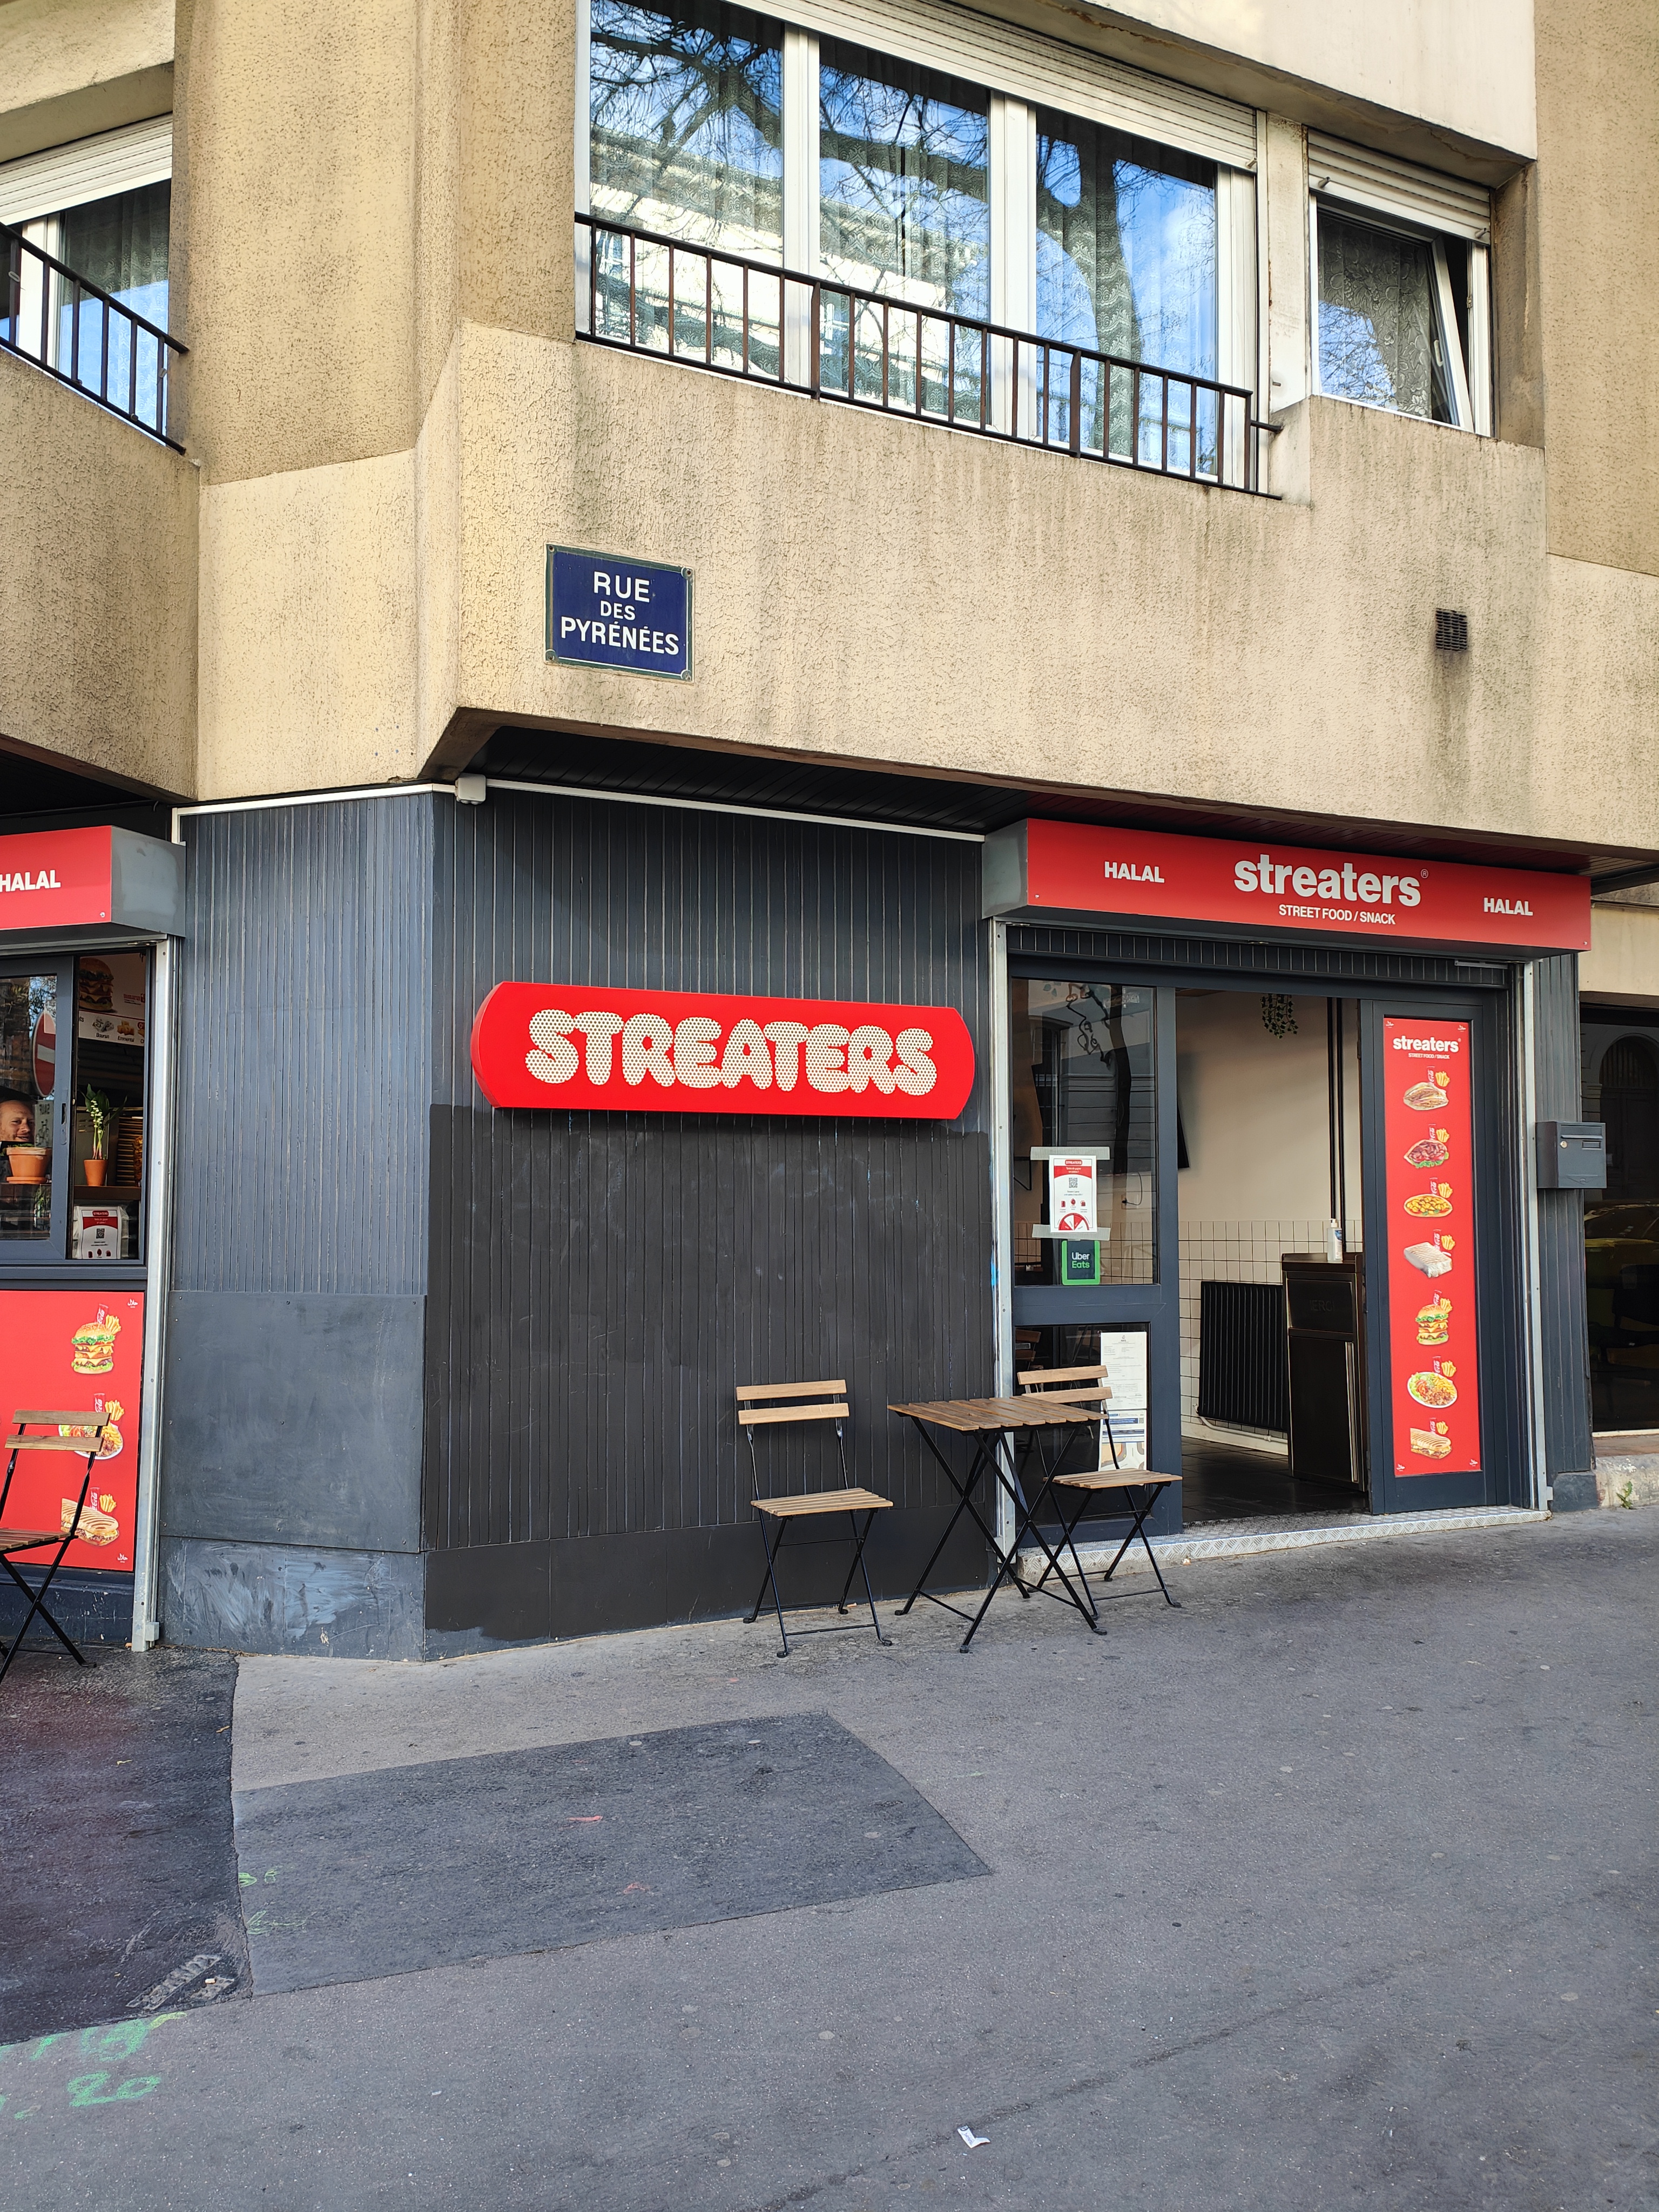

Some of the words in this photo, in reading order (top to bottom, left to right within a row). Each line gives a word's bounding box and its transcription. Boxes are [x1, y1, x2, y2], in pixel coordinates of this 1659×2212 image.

[594, 571, 650, 603] RUE
[600, 600, 636, 621] DES
[561, 616, 679, 656] PYRÉNÉES
[0, 869, 61, 893] HALAL
[1104, 861, 1165, 883] HALAL
[1278, 904, 1321, 919] STREET
[1322, 908, 1352, 921] FOOD
[1359, 911, 1396, 925] SNACK
[1483, 897, 1533, 916] HALAL
[525, 1009, 938, 1096] STREATERS
[1071, 1252, 1090, 1260] Uber
[1071, 1260, 1090, 1269] Eats
[1309, 1299, 1336, 1312] ERCI
